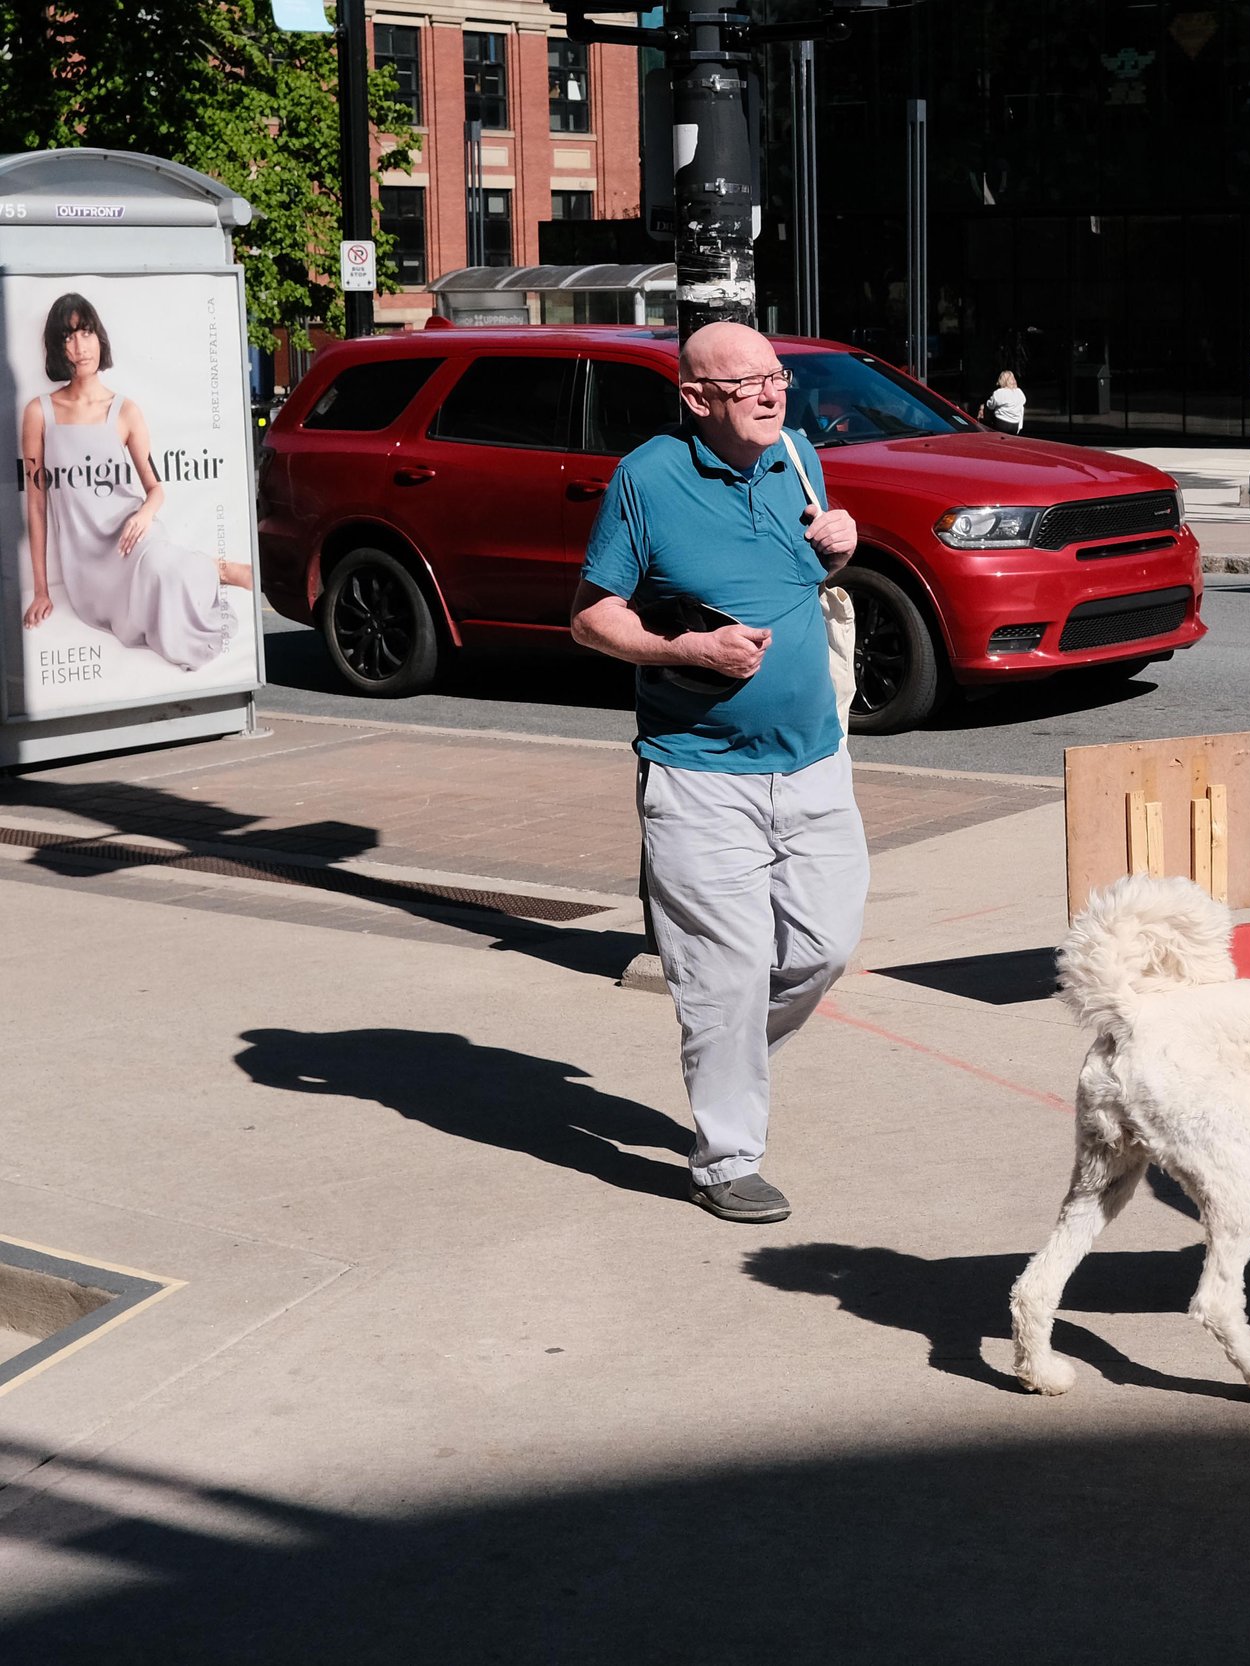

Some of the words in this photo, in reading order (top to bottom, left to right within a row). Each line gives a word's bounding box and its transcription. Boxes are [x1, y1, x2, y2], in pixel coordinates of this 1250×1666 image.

[59, 206, 120, 217] OUTFRONT
[208, 297, 221, 430] FOREIGNAFFAIR.CA
[16, 455, 132, 498] Foreign
[216, 504, 225, 520] RD
[217, 524, 227, 570] GARDEN
[40, 645, 101, 667] EILEEN
[41, 664, 103, 686] FISHER
